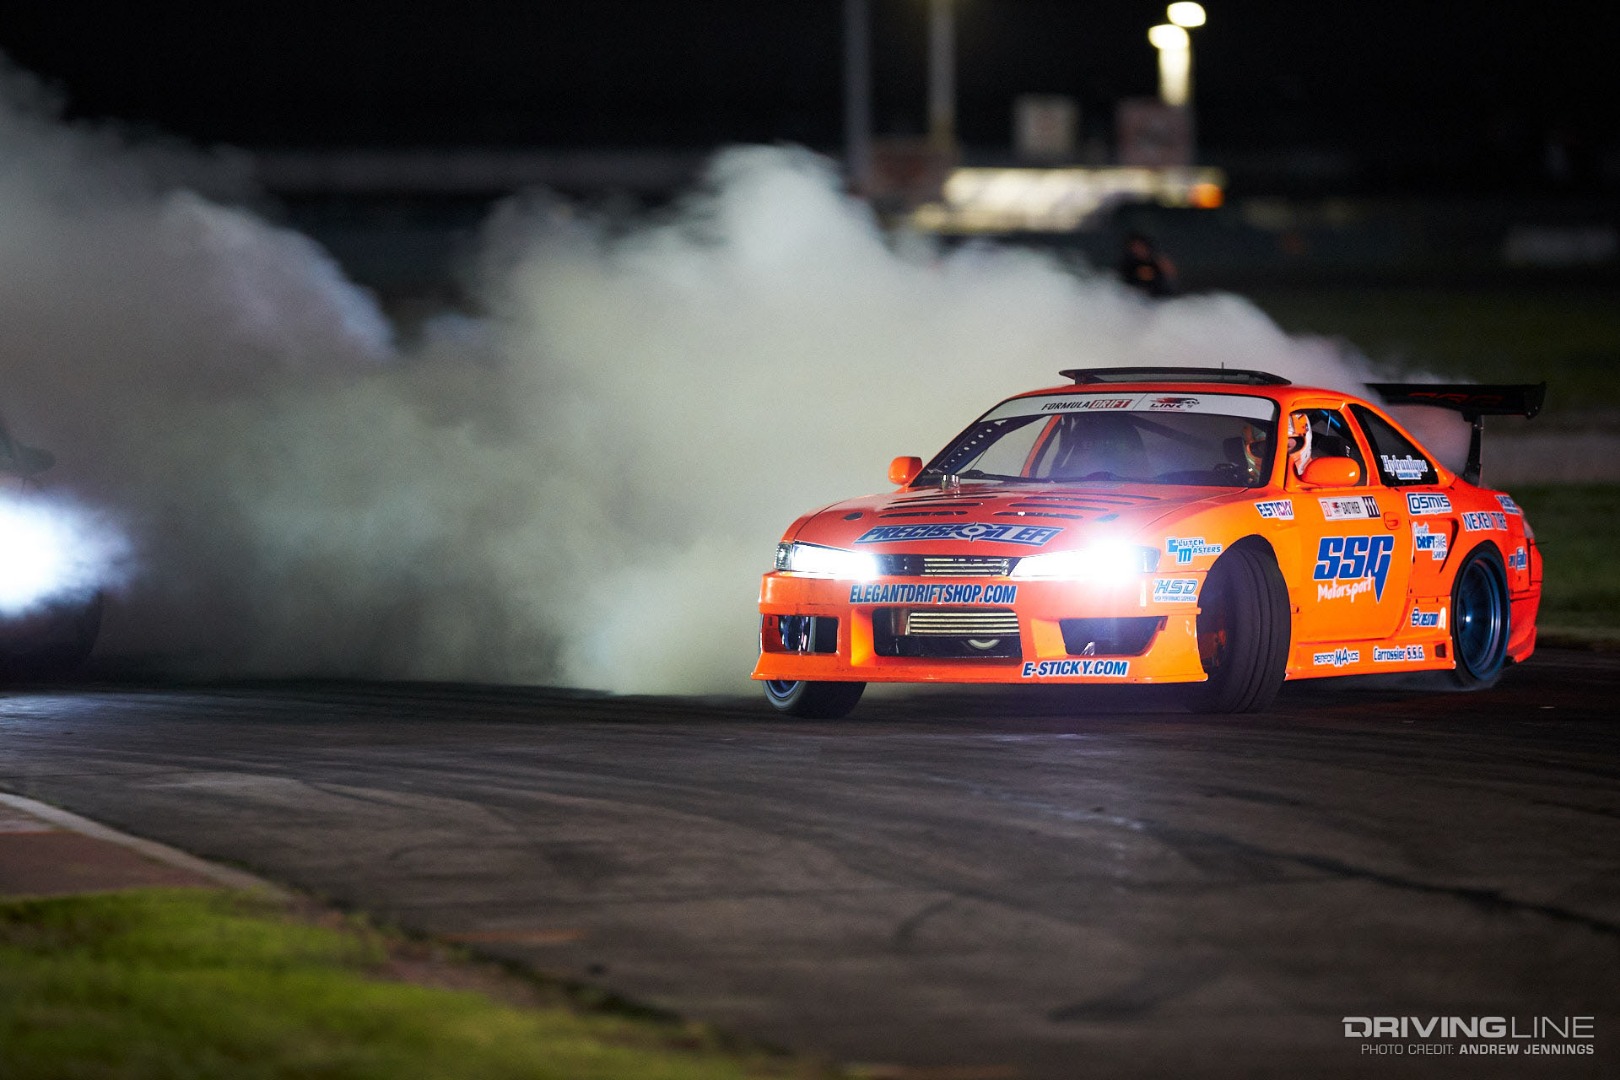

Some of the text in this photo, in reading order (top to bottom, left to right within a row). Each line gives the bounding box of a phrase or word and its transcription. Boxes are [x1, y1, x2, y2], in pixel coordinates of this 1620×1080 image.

[1463, 513, 1493, 530] NEXEN
[1011, 526, 1061, 543] EFI
[1313, 535, 1394, 602] SSG
[850, 584, 1017, 604] ELEGANTDRIFTSHOP.COM
[1154, 579, 1198, 594] HSD
[1317, 569, 1373, 602] Motorsport
[1374, 647, 1405, 660] Carrossier
[1022, 661, 1129, 677] E-STICKY.COM
